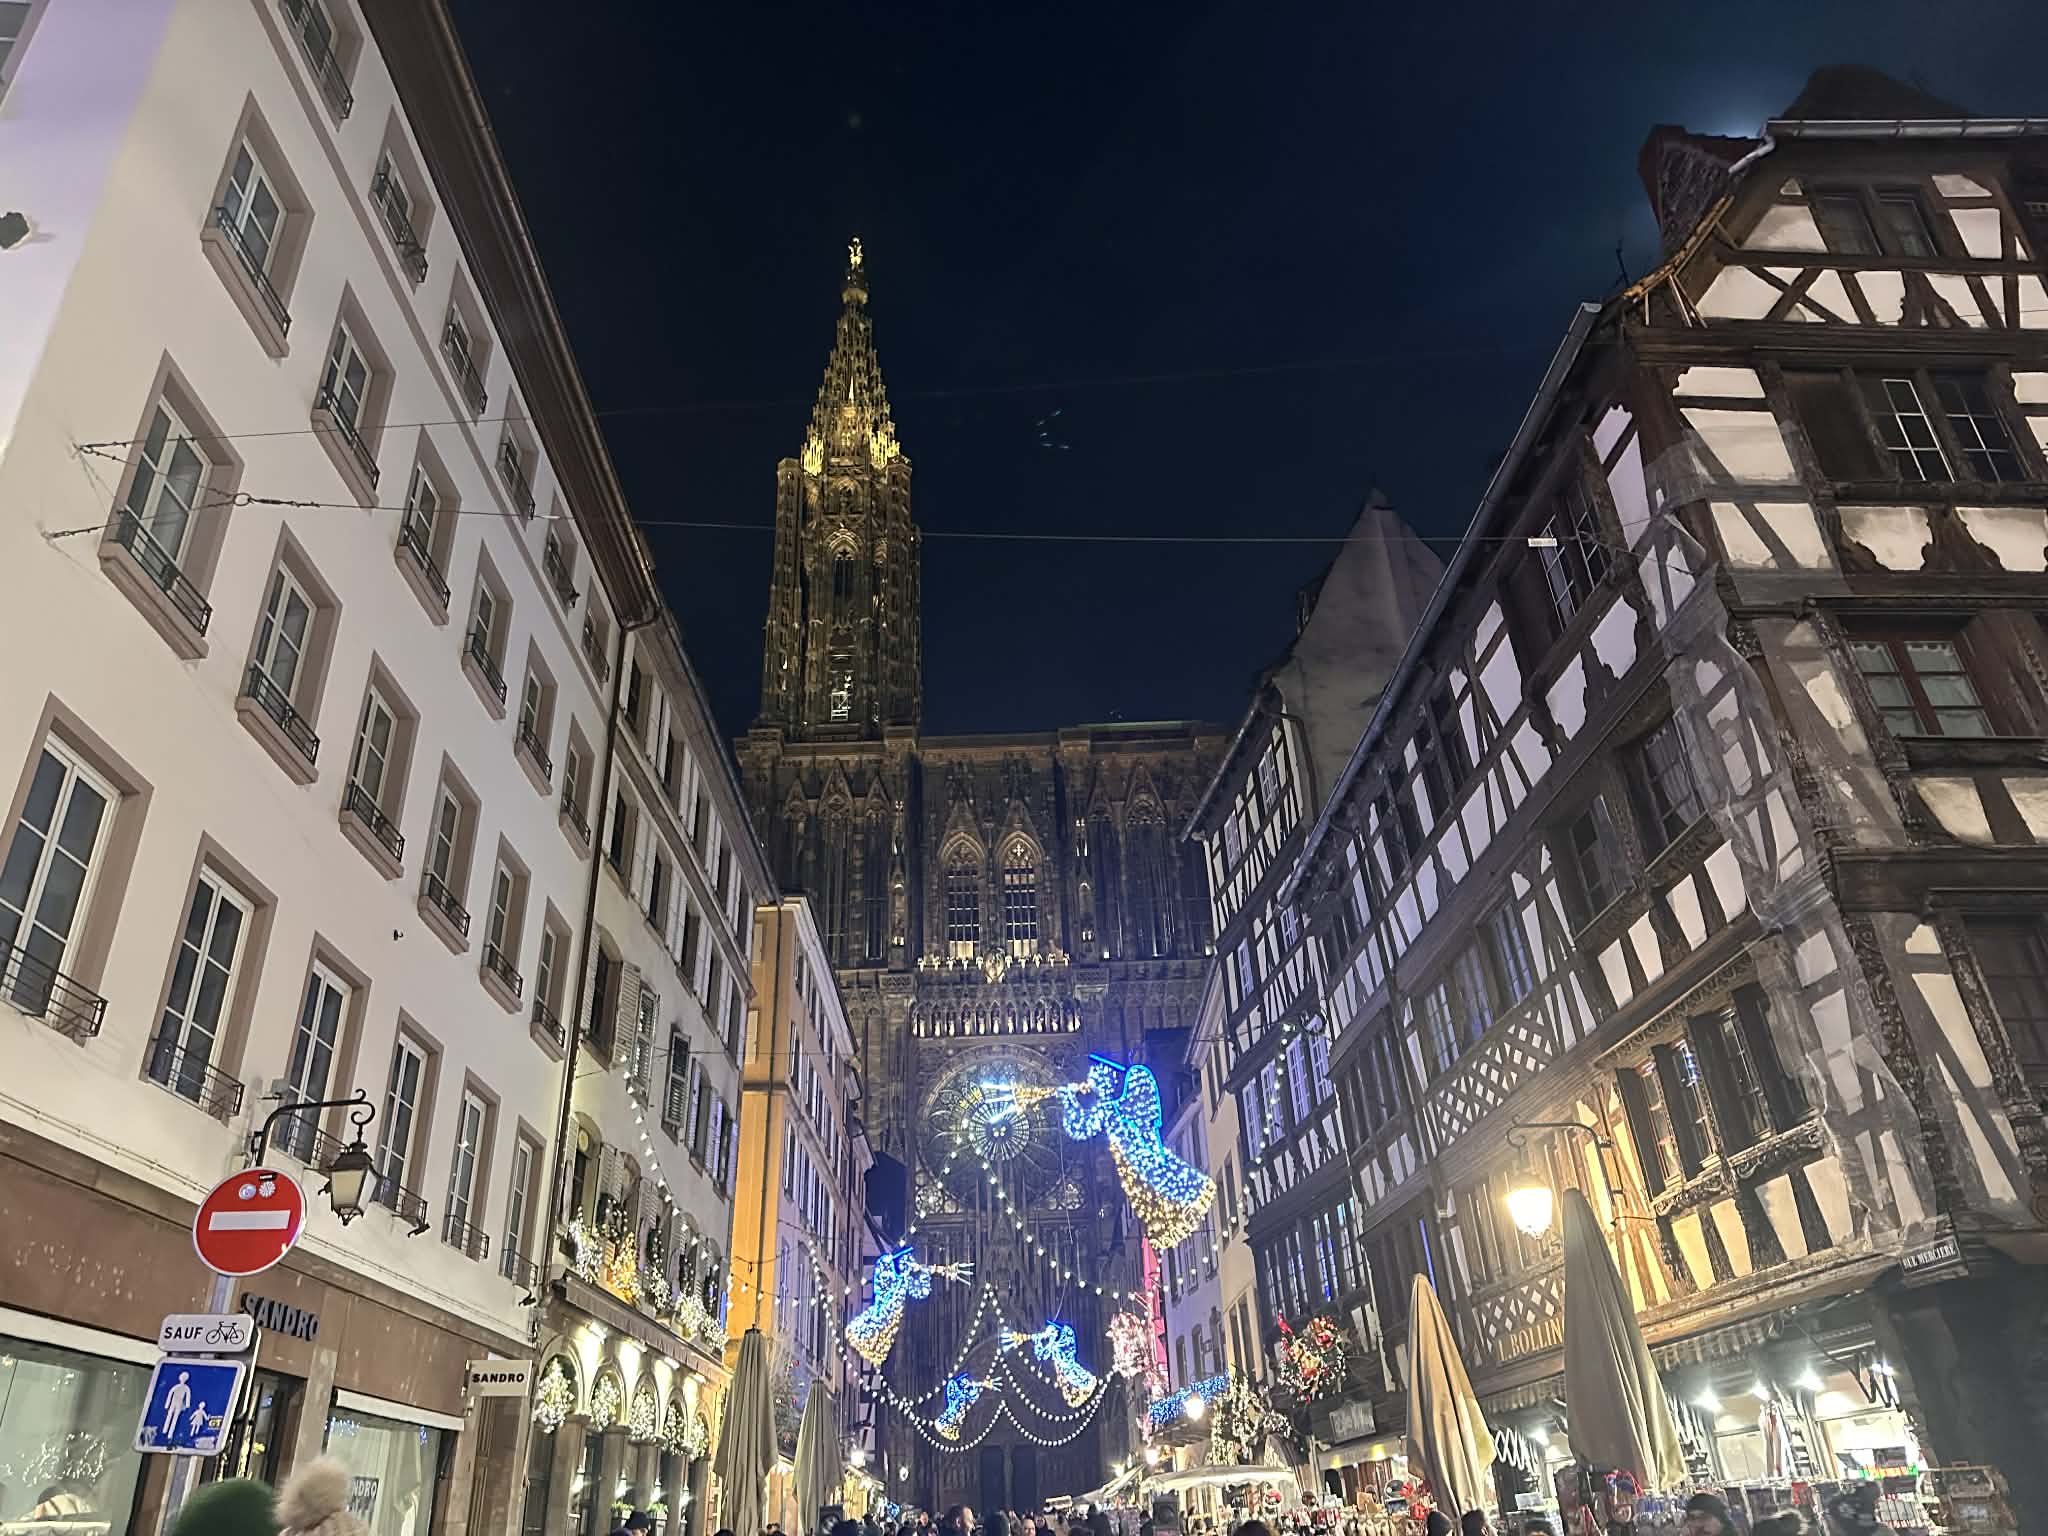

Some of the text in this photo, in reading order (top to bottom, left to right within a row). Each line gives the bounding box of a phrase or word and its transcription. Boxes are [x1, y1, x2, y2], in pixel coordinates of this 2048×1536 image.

[241, 1292, 320, 1342] SANDRO
[164, 1326, 204, 1340] SAUF
[472, 1372, 525, 1384] SANDRO
